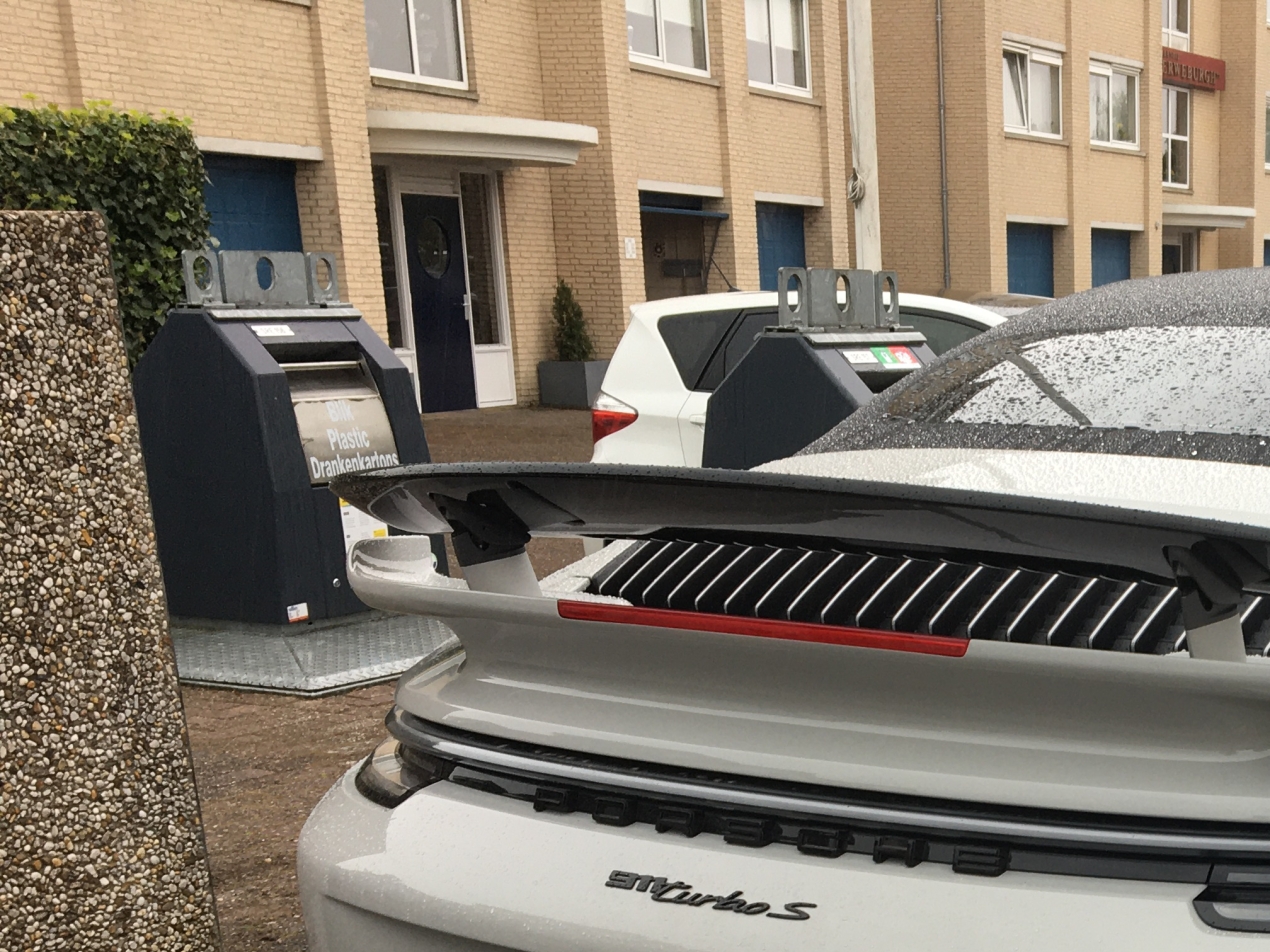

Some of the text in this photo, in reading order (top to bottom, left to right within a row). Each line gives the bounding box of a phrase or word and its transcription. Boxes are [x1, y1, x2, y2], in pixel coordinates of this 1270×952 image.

[325, 400, 355, 422] Blik
[326, 426, 370, 451] Plastic
[310, 451, 400, 479] Drankenkartons
[766, 902, 818, 920] S
